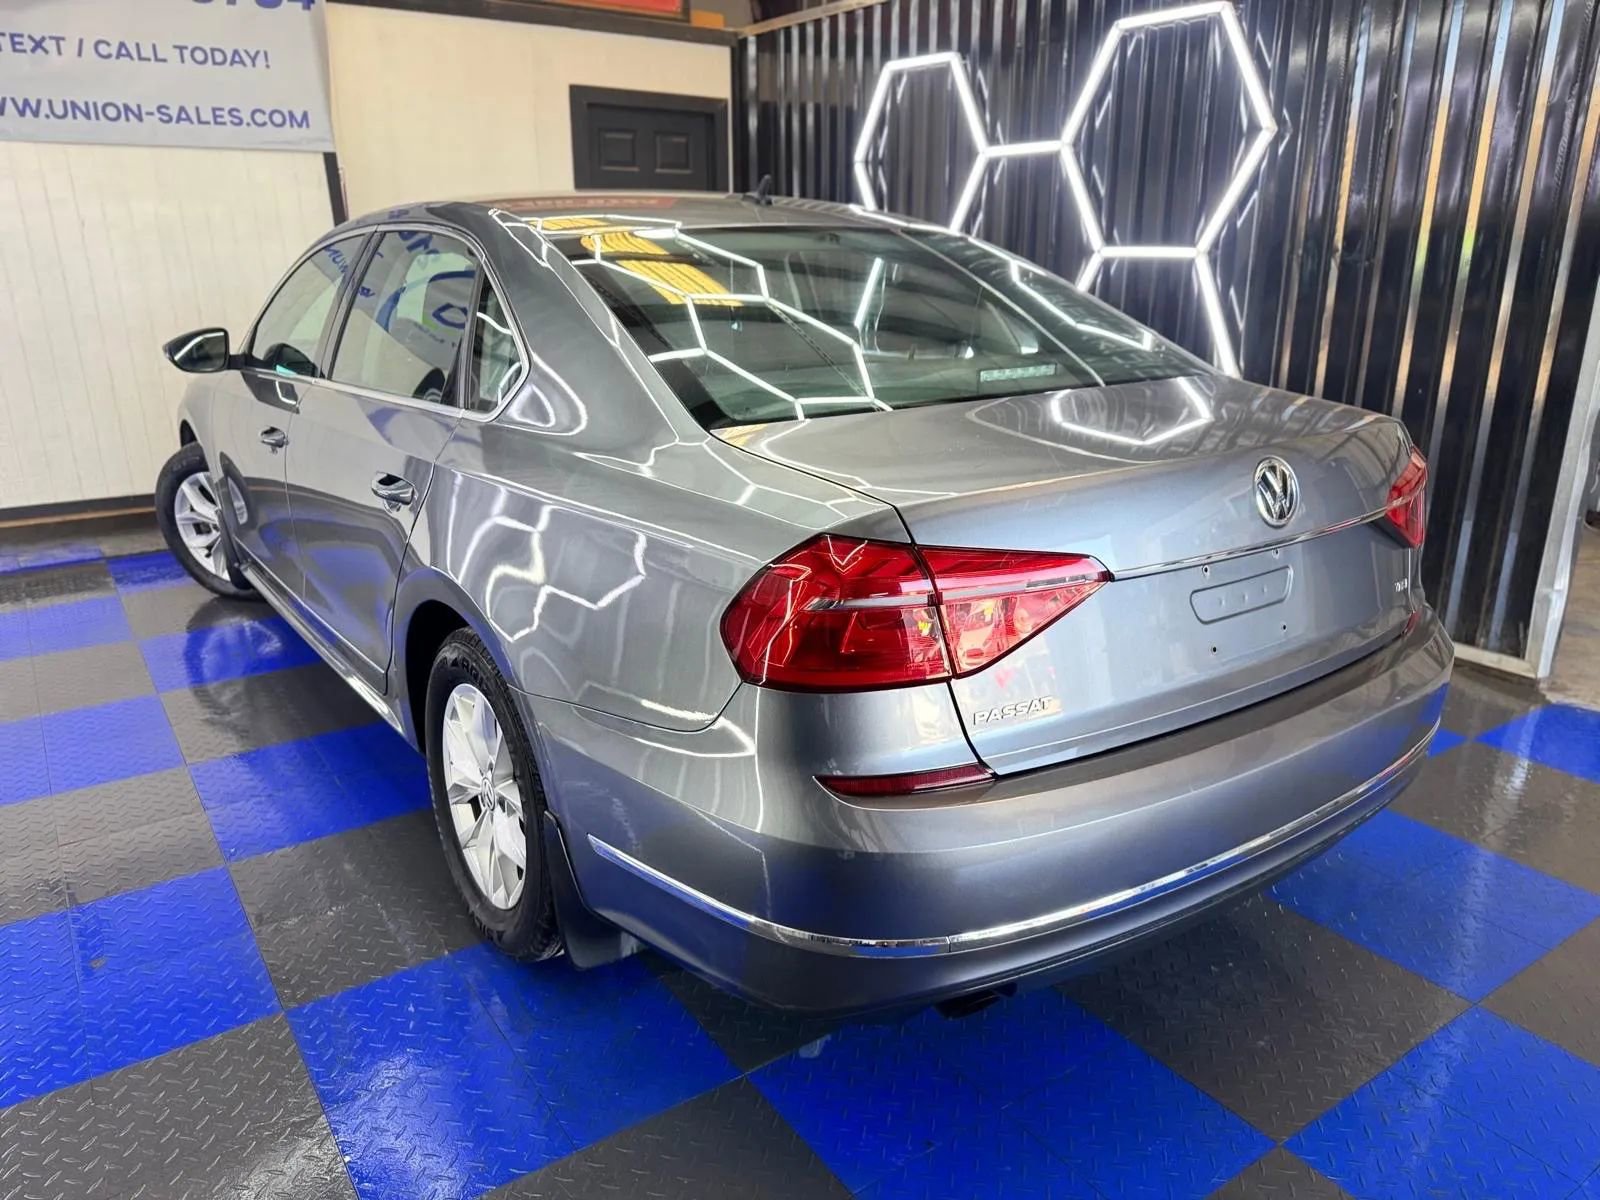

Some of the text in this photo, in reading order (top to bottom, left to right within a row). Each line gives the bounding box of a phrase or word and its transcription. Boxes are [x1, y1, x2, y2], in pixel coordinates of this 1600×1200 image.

[77, 38, 84, 58] /
[93, 39, 168, 63] CALL
[172, 44, 271, 69] TODAY!
[973, 696, 1053, 725] PASSAT
